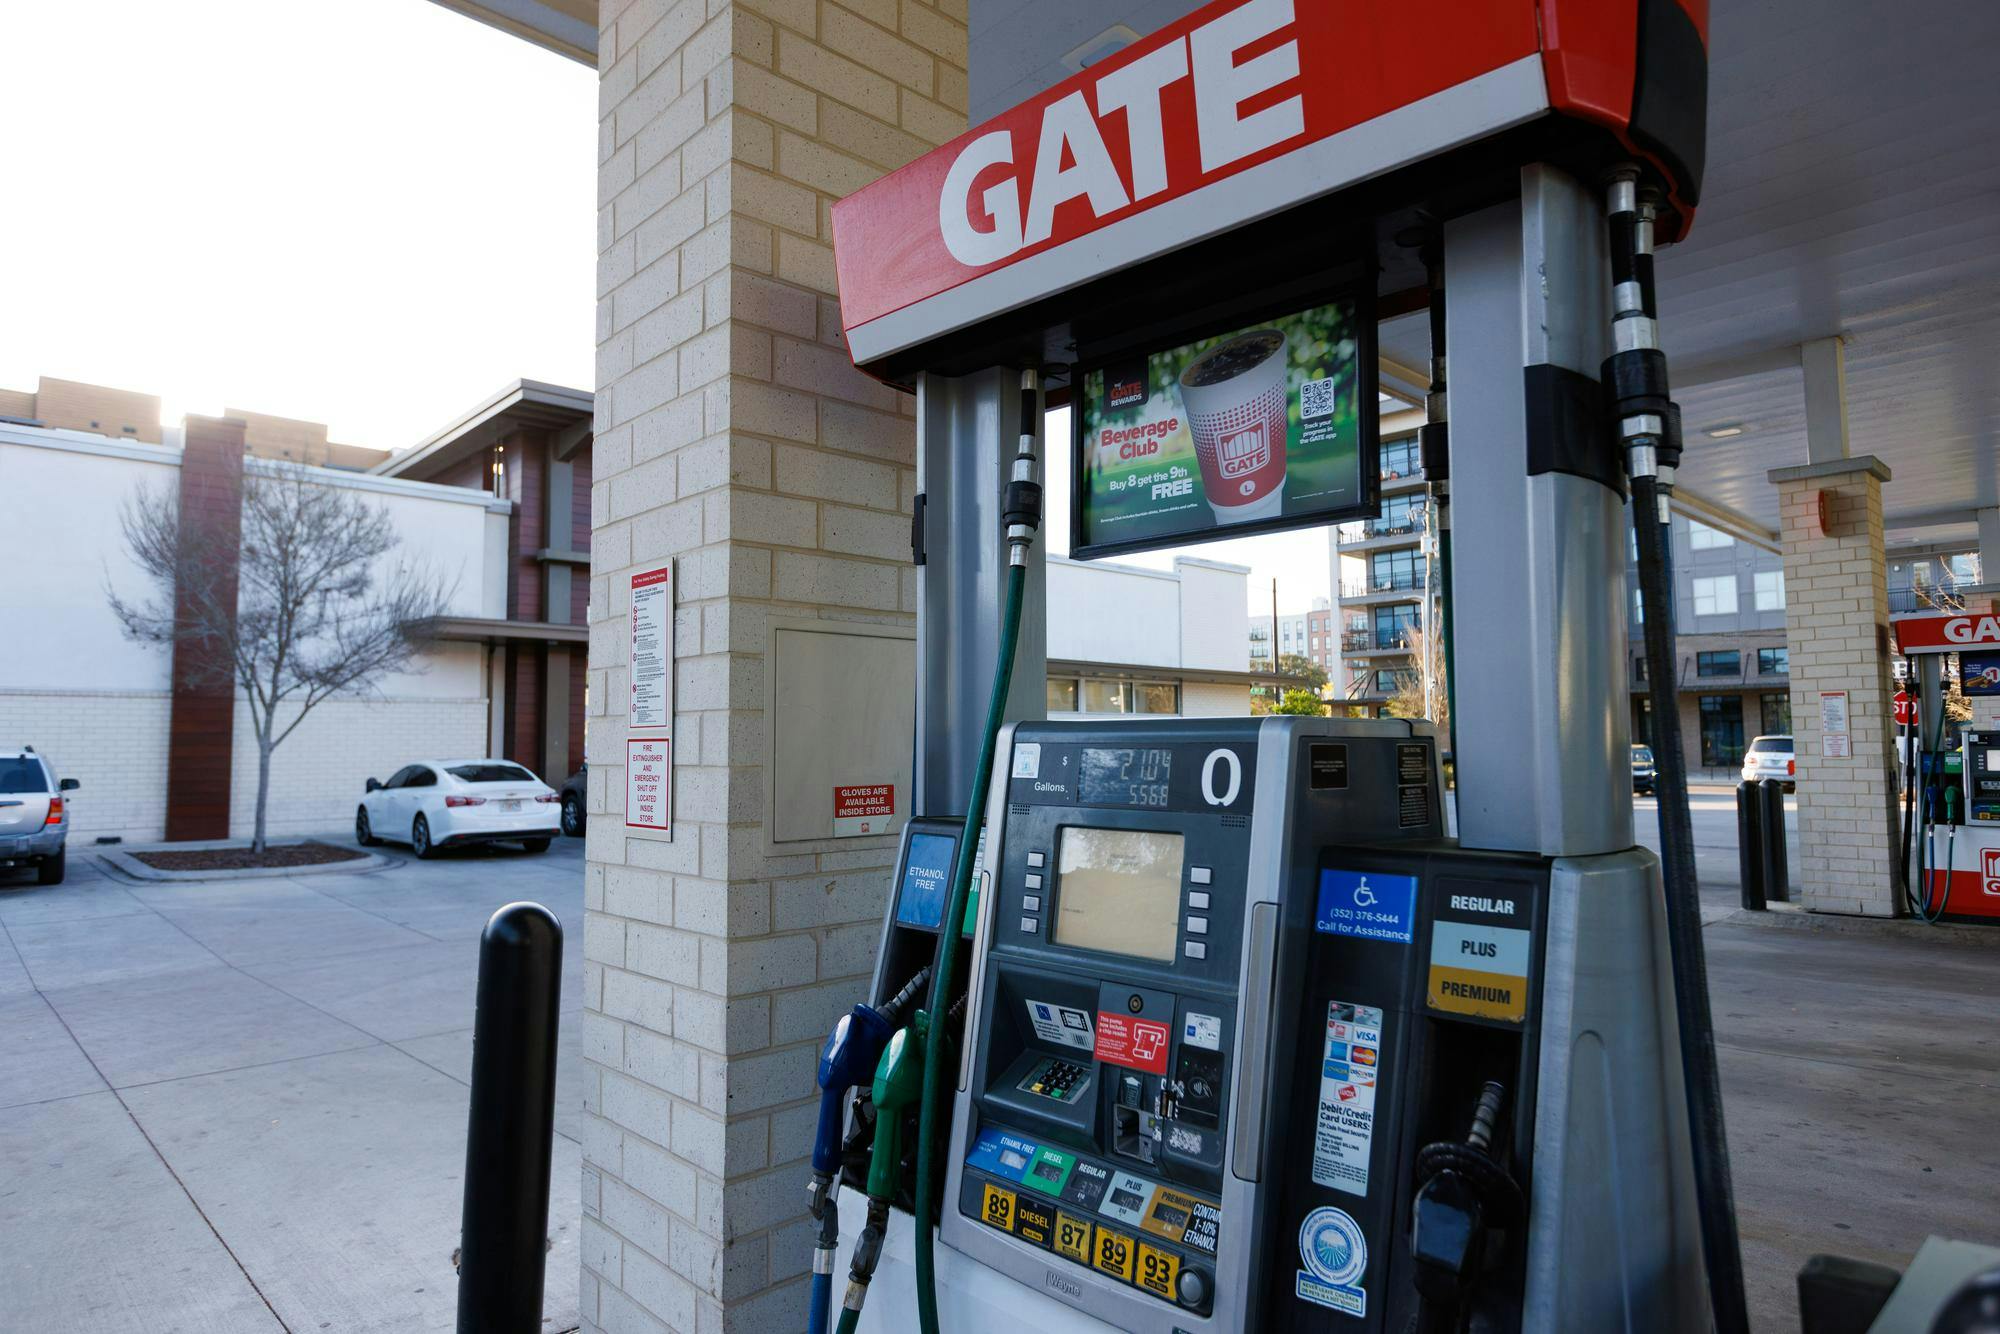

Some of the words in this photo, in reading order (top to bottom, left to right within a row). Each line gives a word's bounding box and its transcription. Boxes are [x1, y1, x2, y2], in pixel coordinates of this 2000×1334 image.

[939, 0, 1305, 267] GATE
[1110, 382, 1142, 399] GATE
[1111, 393, 1142, 407] REWARDS
[1101, 417, 1179, 447] Beverage
[1119, 438, 1158, 460] Club
[1224, 451, 1266, 474] GATE
[1109, 480, 1127, 491] Buy
[1128, 474, 1137, 487] 8
[1137, 475, 1152, 487] get
[1153, 472, 1168, 481] the
[1169, 466, 1188, 479] 9th
[1151, 478, 1193, 500] FREE
[1244, 484, 1251, 492] L
[1944, 616, 2000, 644] GA
[633, 754, 663, 762] EXTINGUISHER
[1062, 756, 1068, 766] $
[634, 774, 660, 782] EMERGENCY
[1034, 781, 1065, 792] Gallons
[841, 788, 871, 796] GLOVES
[873, 787, 888, 795] ARE
[845, 797, 884, 806] AVAILABLE
[839, 808, 864, 816] INSIDE
[866, 806, 890, 814] STORE
[910, 866, 945, 880] ETHANOL
[915, 879, 935, 890] FREE
[1450, 895, 1515, 915] REGULAR
[1330, 908, 1354, 920] (352)
[1355, 911, 1399, 924] 376-5444
[1317, 920, 1336, 932] Call
[1338, 922, 1352, 934] for
[1353, 924, 1410, 941] Assistance
[1461, 940, 1497, 958] PLUS
[1441, 981, 1512, 1005] PREMIUM
[1356, 1030, 1377, 1042] VISA
[1320, 1101, 1372, 1122] Debit/Credit
[1320, 1112, 1340, 1123] Card
[1341, 1117, 1370, 1131] USERS:
[1326, 1123, 1337, 1131] Code
[1000, 1136, 1021, 1150] ETHANOL
[1021, 1143, 1036, 1155] FREE
[1043, 1151, 1064, 1164] DIESEL
[1078, 1163, 1107, 1180] REGULAR
[1125, 1179, 1142, 1191] PLUS
[988, 1193, 1010, 1218] 89
[1161, 1192, 1196, 1209] PREMIUM
[1020, 1209, 1049, 1229] DIESEL
[1194, 1218, 1217, 1236] 1-10%
[1061, 1223, 1085, 1249] 87
[1184, 1229, 1216, 1251] ETHANOL
[1101, 1237, 1126, 1265] 89
[1144, 1254, 1170, 1283] 93
[1049, 1271, 1081, 1297] Wayne
